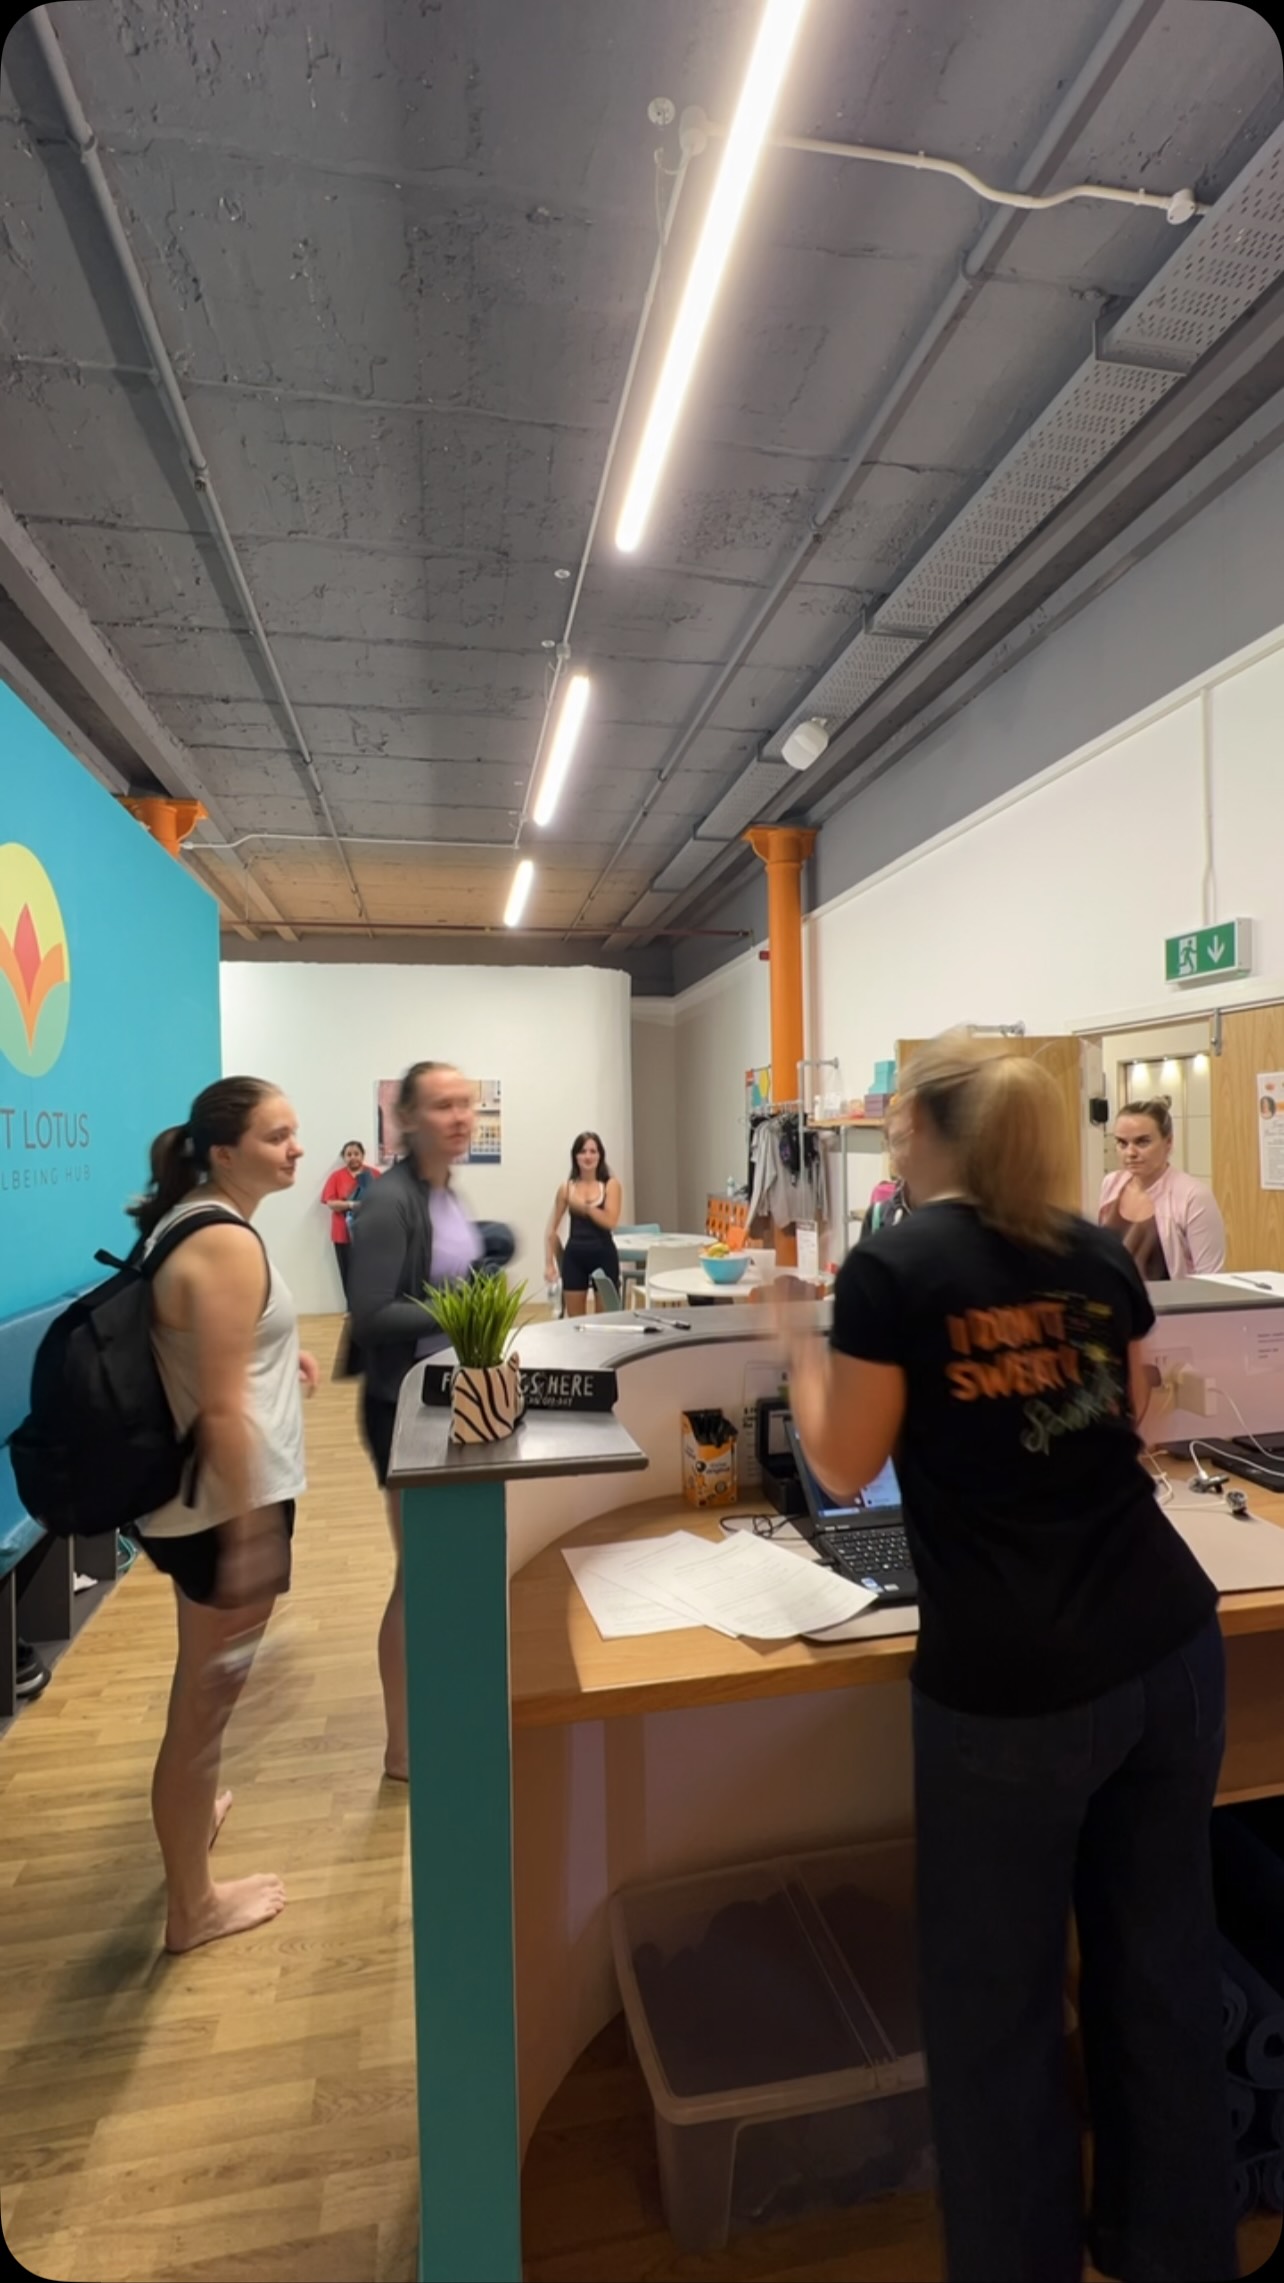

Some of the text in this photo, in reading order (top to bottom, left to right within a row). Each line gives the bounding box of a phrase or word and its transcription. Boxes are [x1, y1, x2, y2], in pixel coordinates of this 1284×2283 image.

[23, 1110, 90, 1149] LOTUS
[65, 1164, 91, 1183] HUB
[547, 1373, 594, 1397] HERE
